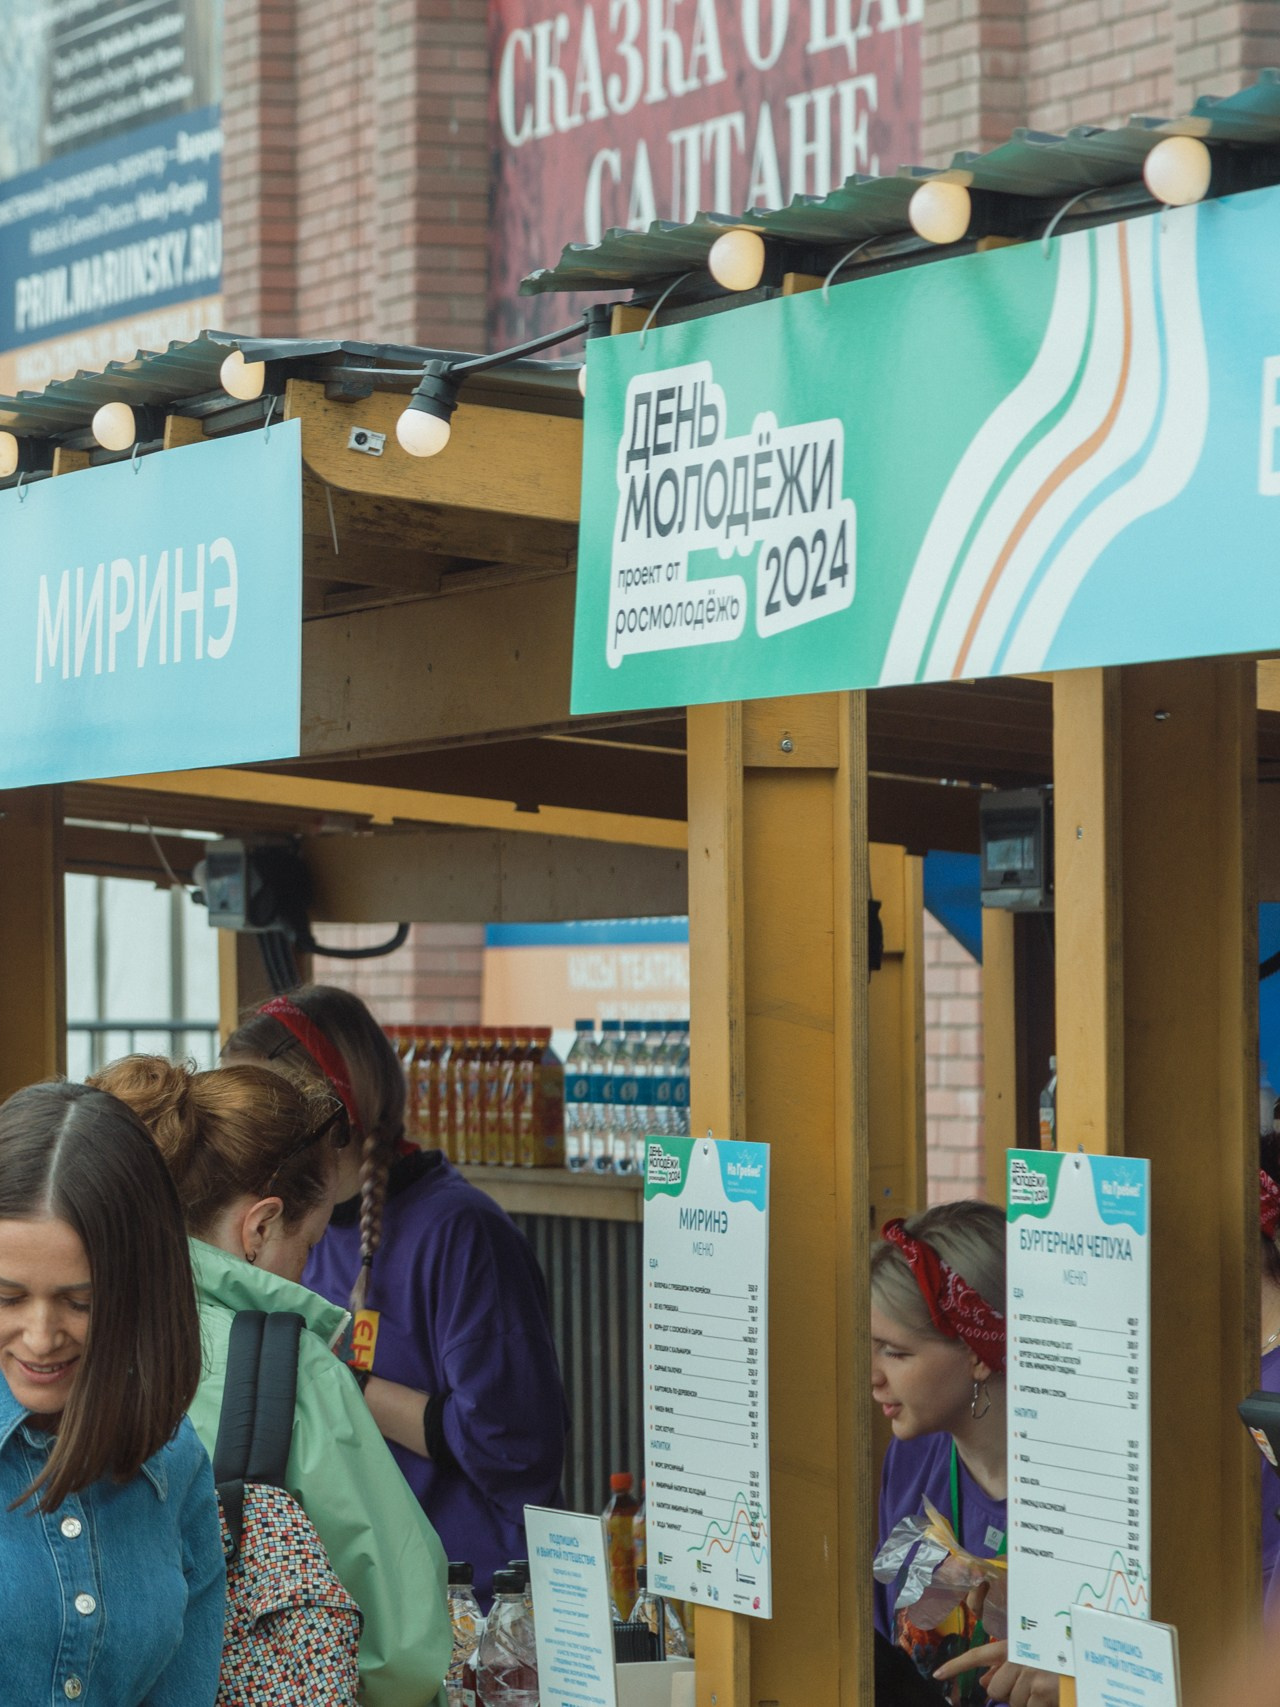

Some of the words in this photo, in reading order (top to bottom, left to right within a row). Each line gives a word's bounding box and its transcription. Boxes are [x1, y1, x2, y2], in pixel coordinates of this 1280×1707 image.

[497, 0, 728, 148] СКАЗКА
[583, 73, 880, 246] САЛТАНЕ
[626, 380, 719, 474] ДЕНЬ
[621, 431, 835, 543] МОЛОДЁЖИ
[617, 562, 662, 594] проект
[666, 561, 680, 582] от
[764, 519, 849, 617] 2024
[35, 536, 239, 684] МИРИНЭ
[614, 589, 740, 650] росмолодёжь
[679, 1207, 728, 1234] МИРИНЭ
[692, 1241, 714, 1257] МЕНЮ
[1020, 1228, 1084, 1257] БУРГЕРНАЯ
[1086, 1235, 1133, 1262] ЧЕПУХА
[1063, 1269, 1088, 1287] МЕНЮ
